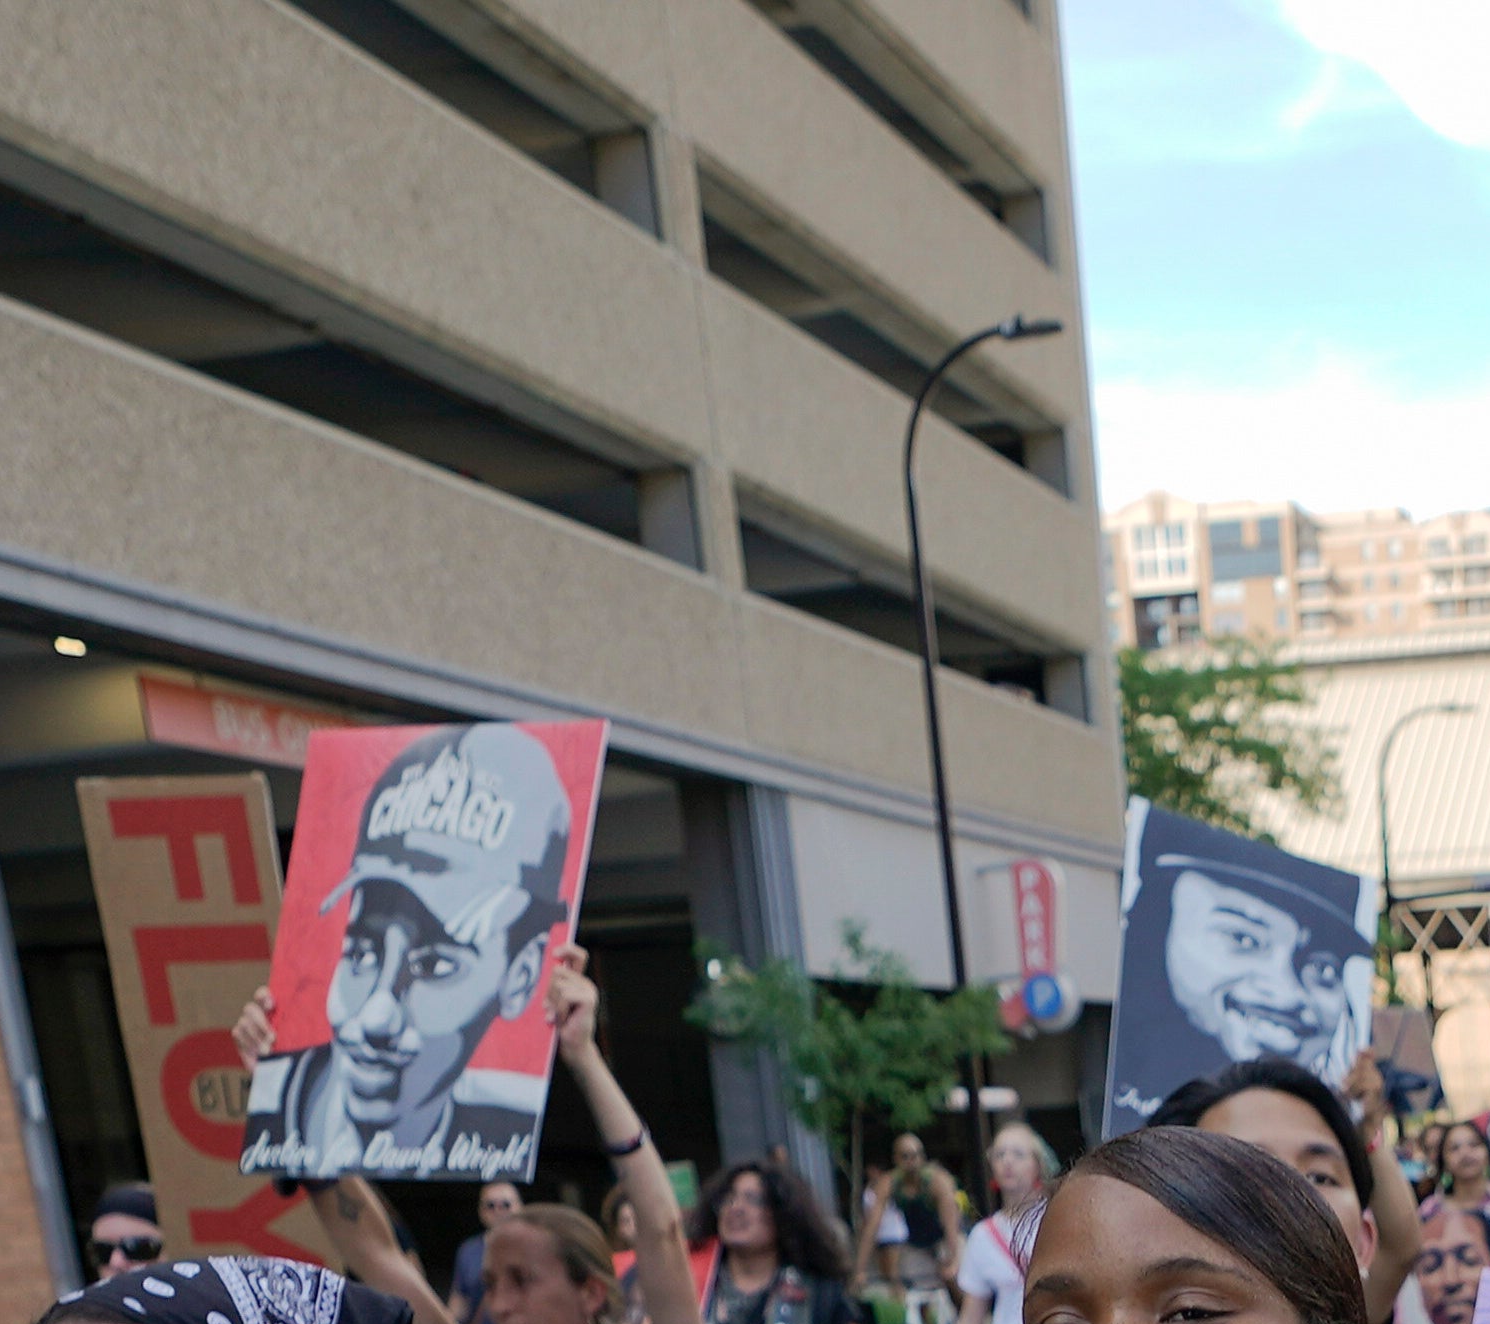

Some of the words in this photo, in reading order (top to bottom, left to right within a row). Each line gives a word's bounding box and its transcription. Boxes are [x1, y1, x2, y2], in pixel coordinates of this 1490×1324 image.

[367, 768, 514, 850] CHICAGO
[1019, 867, 1047, 967] PARK
[107, 795, 330, 1268] FLOY
[447, 1131, 532, 1180] Wright
